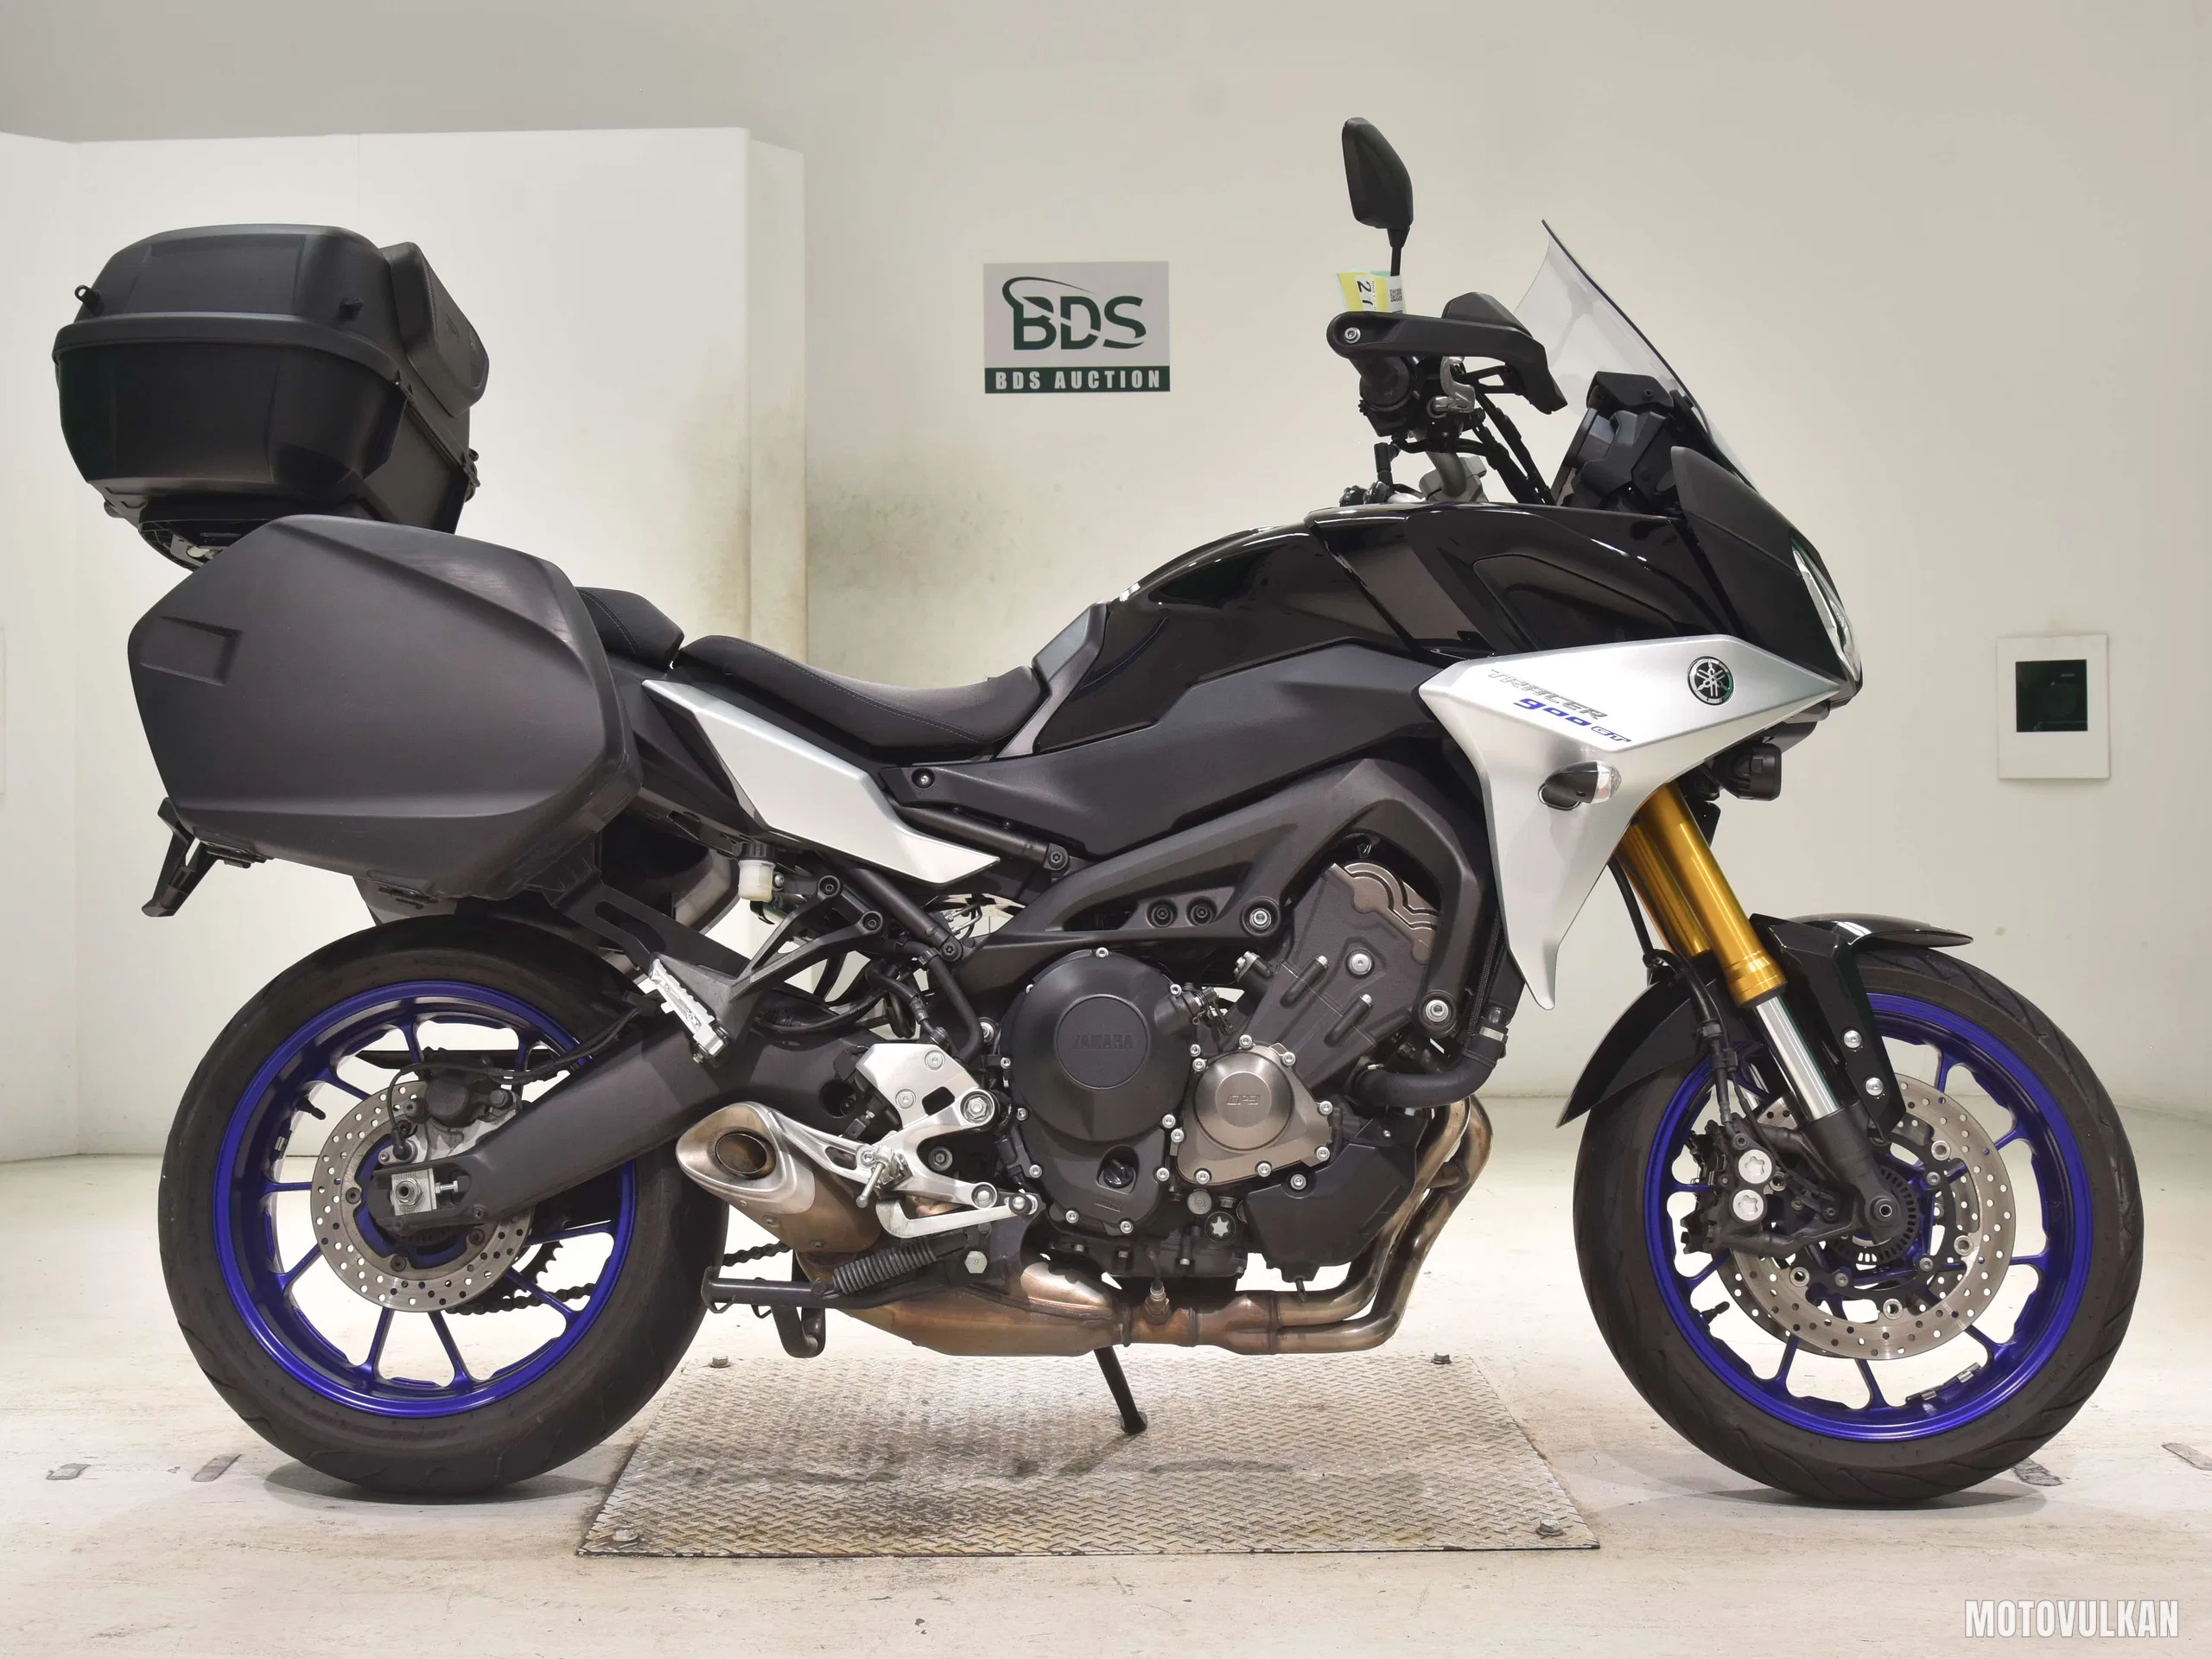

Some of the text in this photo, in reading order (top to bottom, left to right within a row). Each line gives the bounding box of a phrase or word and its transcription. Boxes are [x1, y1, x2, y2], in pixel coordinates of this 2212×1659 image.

[1002, 276, 1147, 350] BDS
[995, 370, 1160, 390] BDS AUCTION
[1488, 669, 1608, 720] TRACER
[1514, 697, 1631, 742] 900 GT
[1071, 1033, 1134, 1051] YAMAHA
